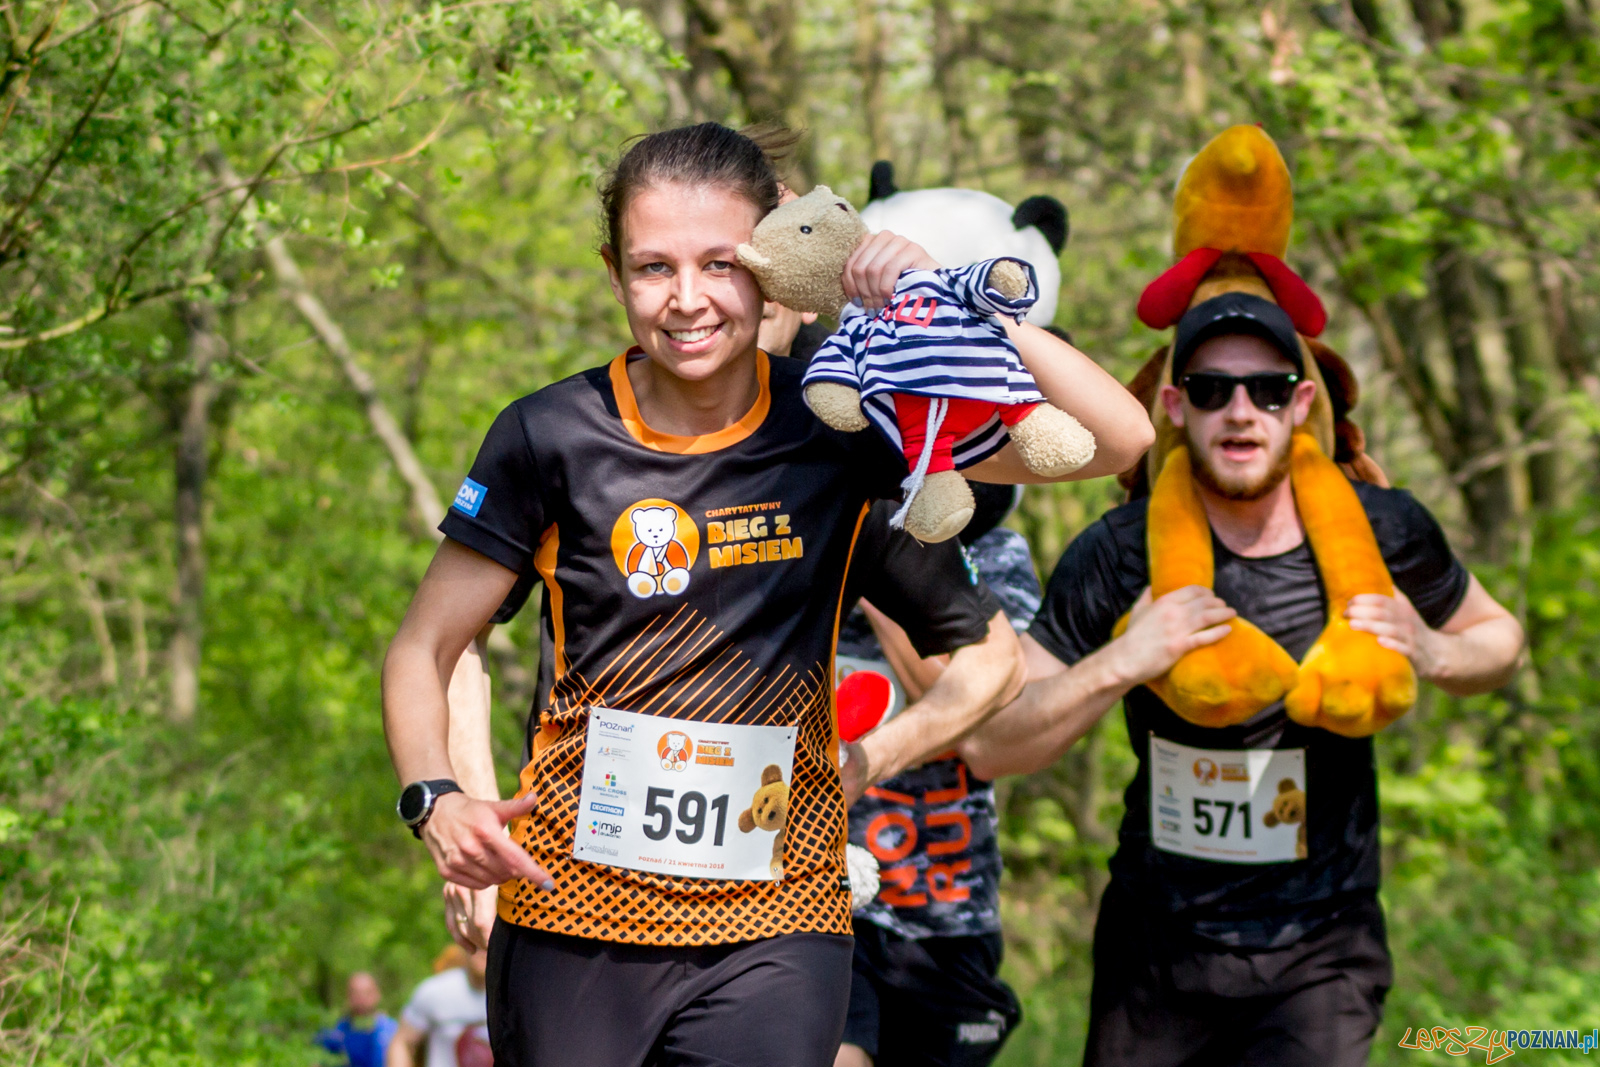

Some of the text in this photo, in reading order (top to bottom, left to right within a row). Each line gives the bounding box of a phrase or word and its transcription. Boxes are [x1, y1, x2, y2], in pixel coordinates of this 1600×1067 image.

[457, 484, 479, 504] ON
[705, 501, 781, 518] CHARYTATYWNY
[707, 514, 791, 544] BIEG Z
[708, 537, 803, 569] MISIEM
[592, 803, 623, 816] DECATHLON
[643, 786, 729, 846] 591
[1193, 797, 1252, 839] 571
[601, 821, 622, 835] mjp
[924, 752, 972, 902] RUL
